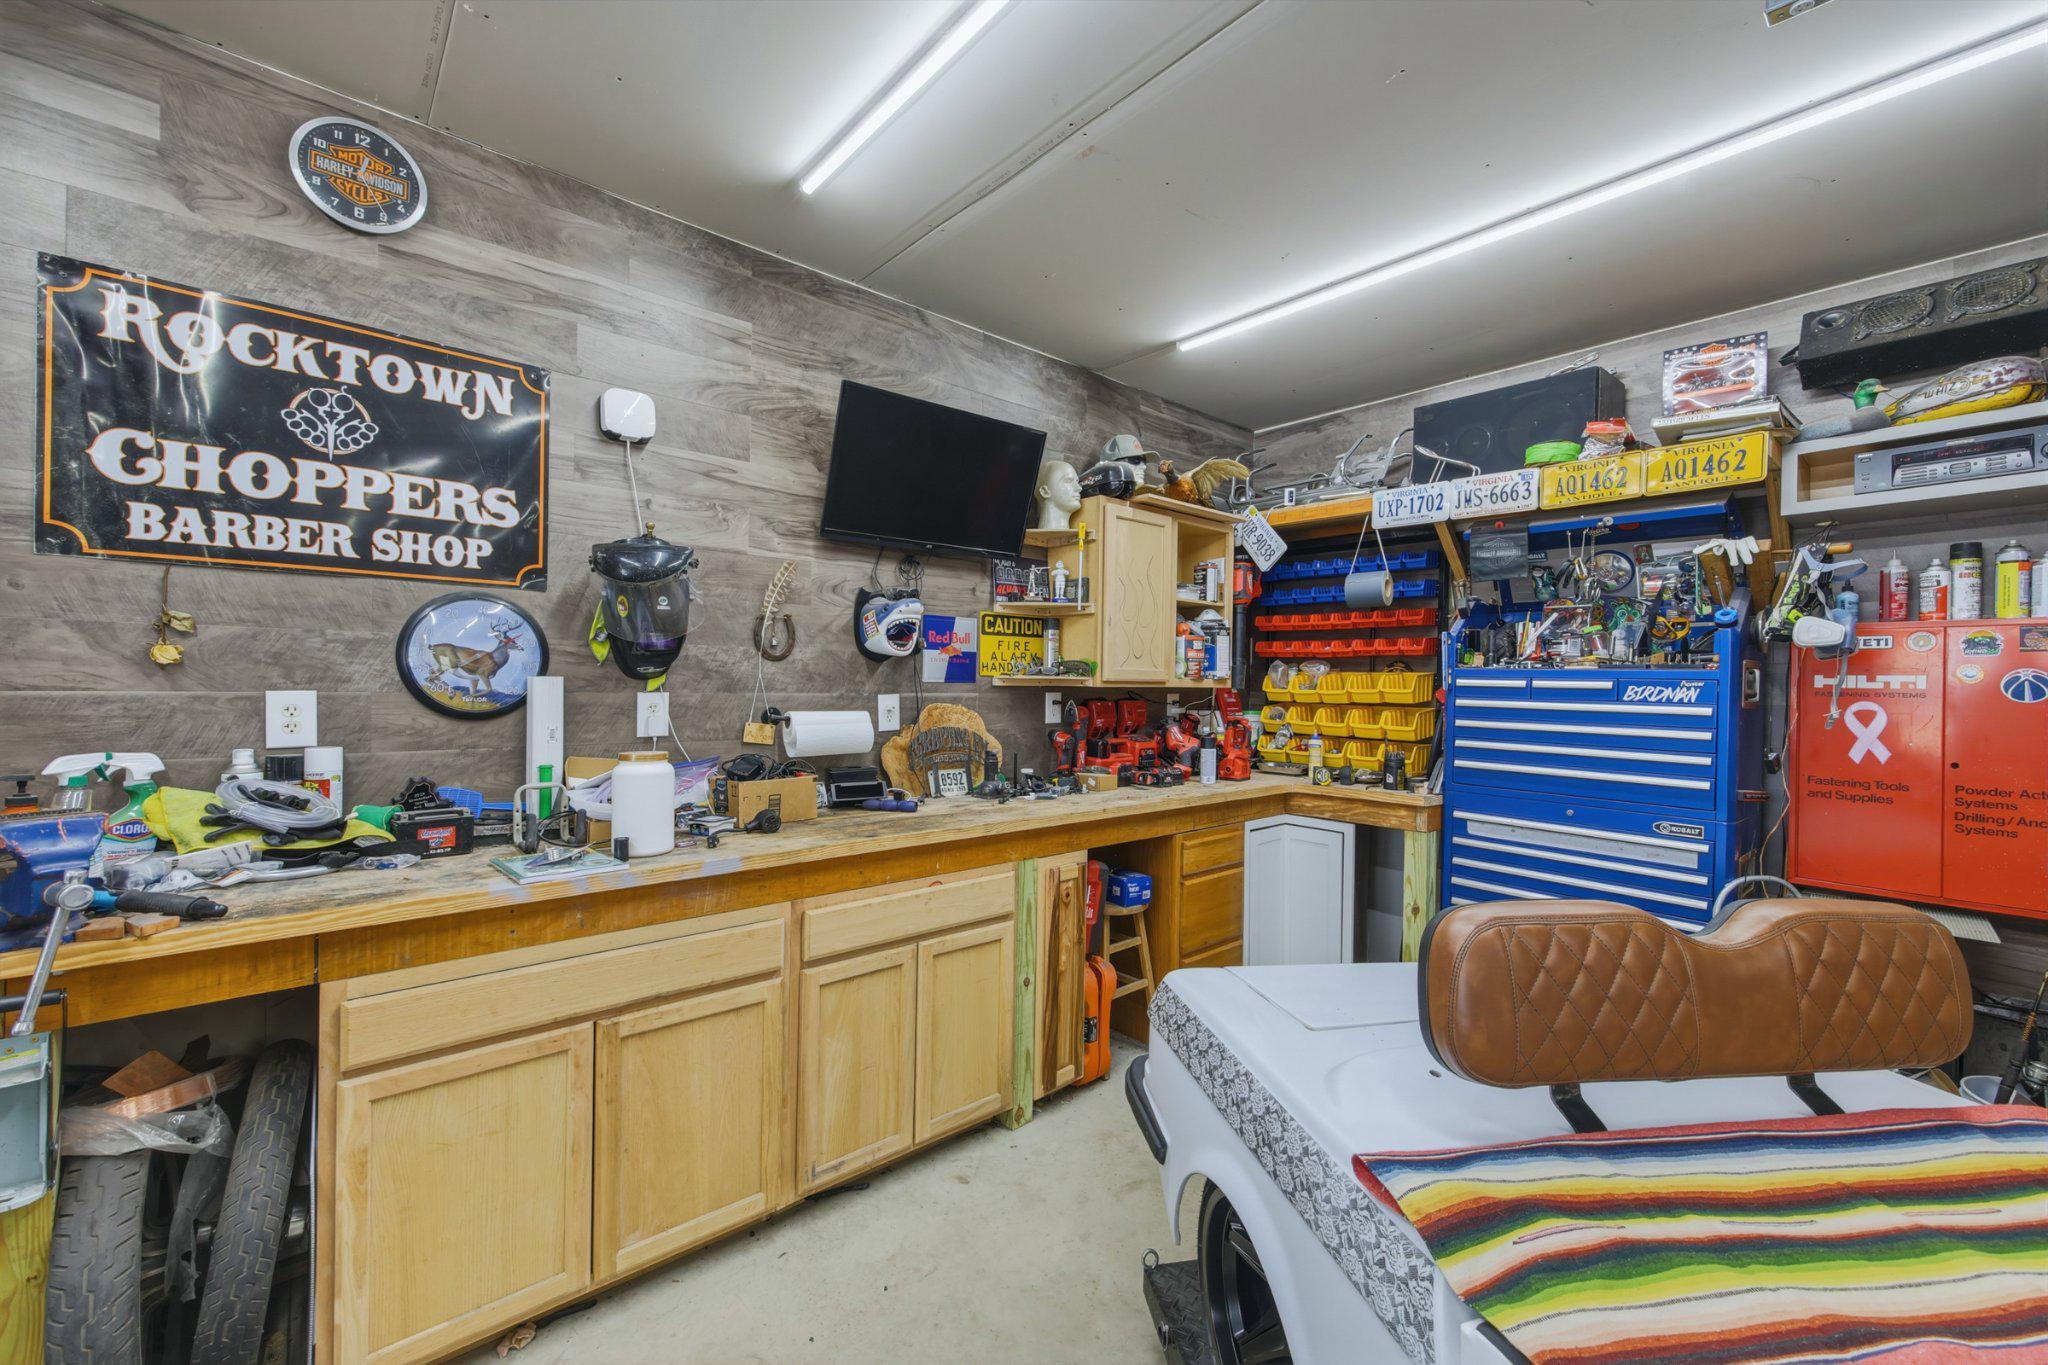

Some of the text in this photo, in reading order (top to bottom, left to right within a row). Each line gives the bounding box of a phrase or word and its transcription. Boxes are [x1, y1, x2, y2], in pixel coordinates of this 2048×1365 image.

[313, 137, 326, 149] 10
[354, 133, 370, 148] 12
[398, 167, 407, 177] 2
[312, 175, 321, 186] 8
[331, 196, 339, 206] 7
[354, 206, 365, 219] 6
[97, 287, 514, 421] ROCKTOWN
[1672, 441, 1736, 457] VIRGINIA
[1565, 458, 1618, 473] VIRGINIA
[1660, 449, 1748, 483] AQ1462
[85, 427, 522, 529] CHOPPERS
[1472, 475, 1514, 487] VIRGINIA
[1555, 466, 1629, 497] AQ1462
[1672, 476, 1732, 488] ANTIQUE
[1391, 487, 1428, 498] VIRGINIA
[1566, 491, 1617, 503] ANTIQUE
[1378, 493, 1444, 518] UXP-1702
[125, 500, 495, 571] BARBER SHOP
[984, 616, 1043, 636] CAUTION
[928, 630, 971, 645] Red Bull
[997, 640, 1031, 652] FIRE
[1622, 685, 1700, 703] BIRDMAN
[940, 771, 965, 786] 8592
[1807, 775, 1910, 792] Fastening Tools
[1807, 790, 1894, 805] and Supplies
[1954, 784, 2015, 798] Powder
[1954, 797, 2018, 811] Systems
[1671, 826, 1701, 835] KOBALT
[1954, 824, 2018, 839] Systems
